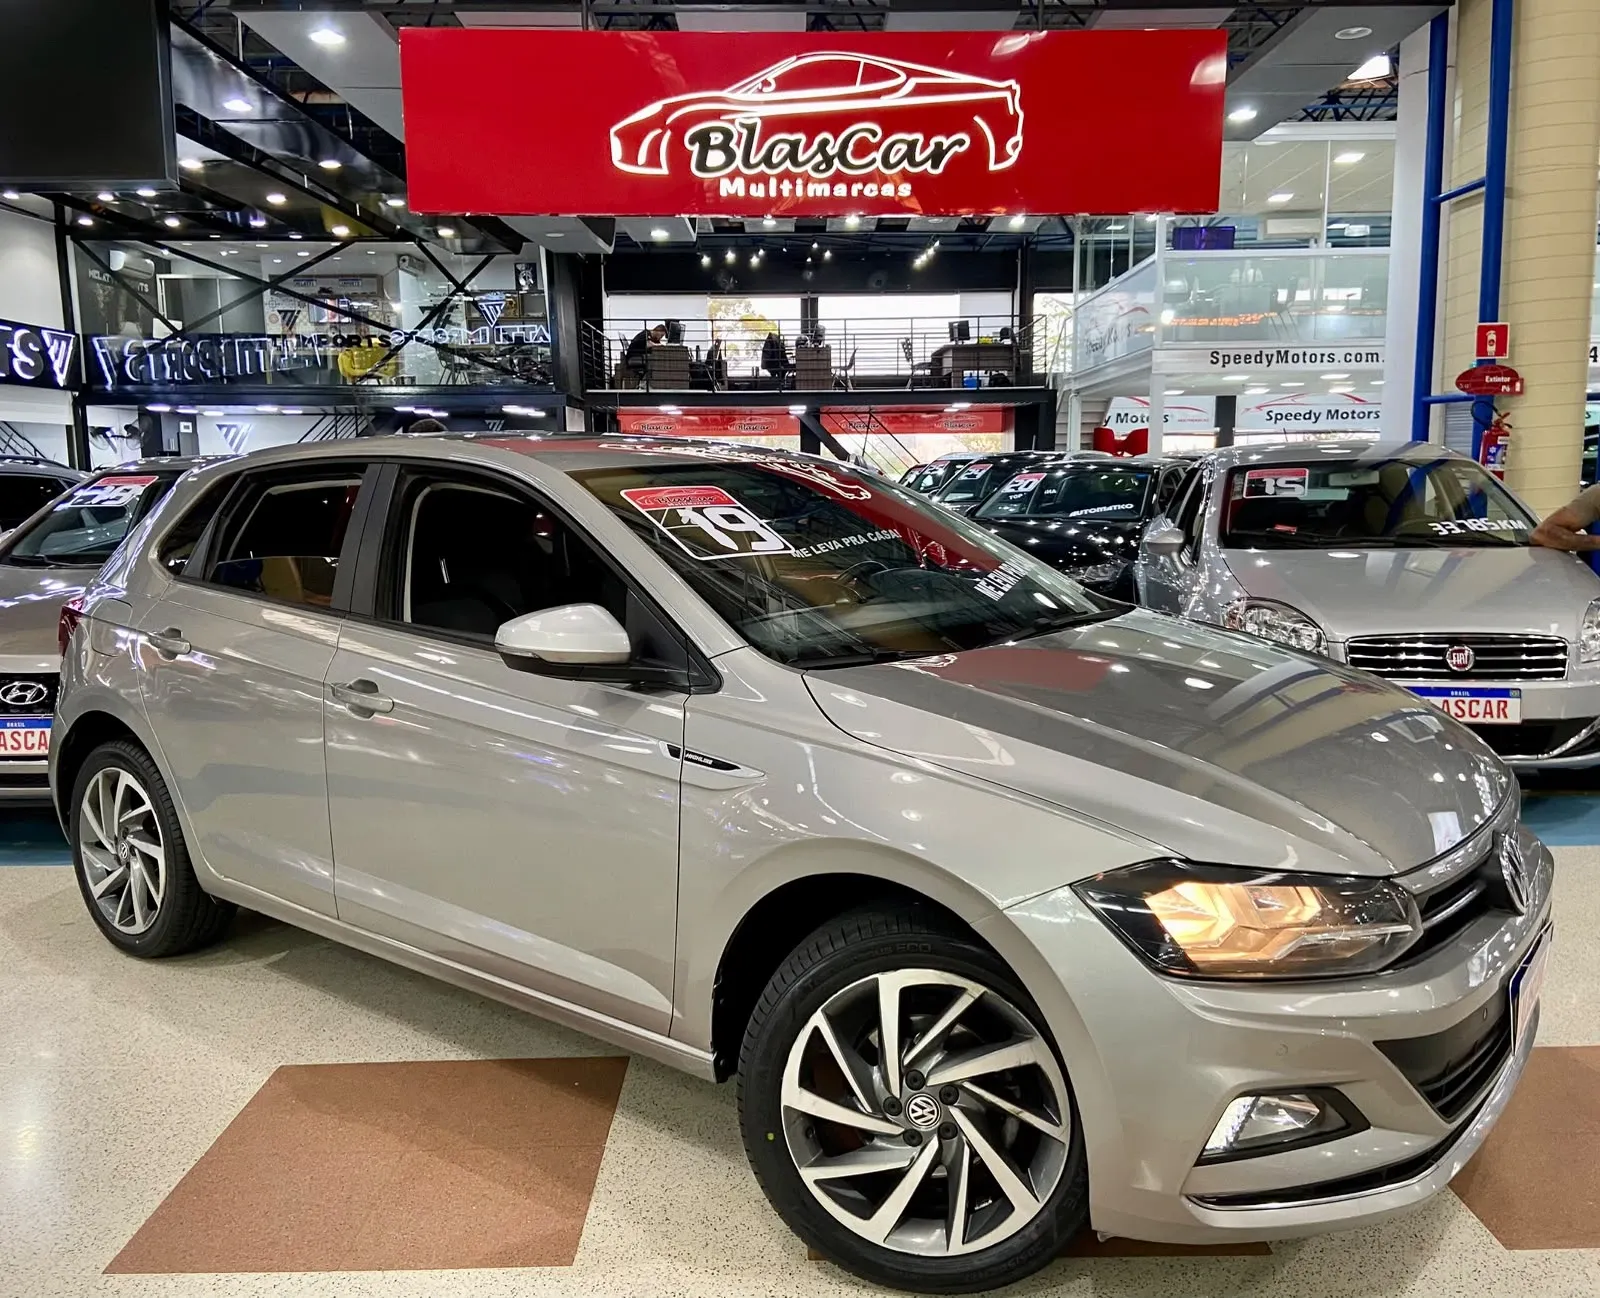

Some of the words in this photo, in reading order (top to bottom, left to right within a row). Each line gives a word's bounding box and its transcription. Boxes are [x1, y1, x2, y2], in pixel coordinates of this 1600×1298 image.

[686, 118, 969, 178] BlasCar
[719, 177, 912, 198] Multimarcas
[1209, 350, 1385, 368] SpeedyMotors.com.
[1485, 375, 1511, 383] Extintor
[1265, 408, 1322, 423] Speedy
[1326, 408, 1381, 420] Motors
[1262, 477, 1305, 495] 15
[676, 506, 786, 551] 19
[791, 545, 811, 561] ME
[809, 538, 844, 557] LEVA
[844, 533, 867, 549] PRA
[867, 528, 903, 544] CASA!
[1452, 652, 1469, 665] FIAT
